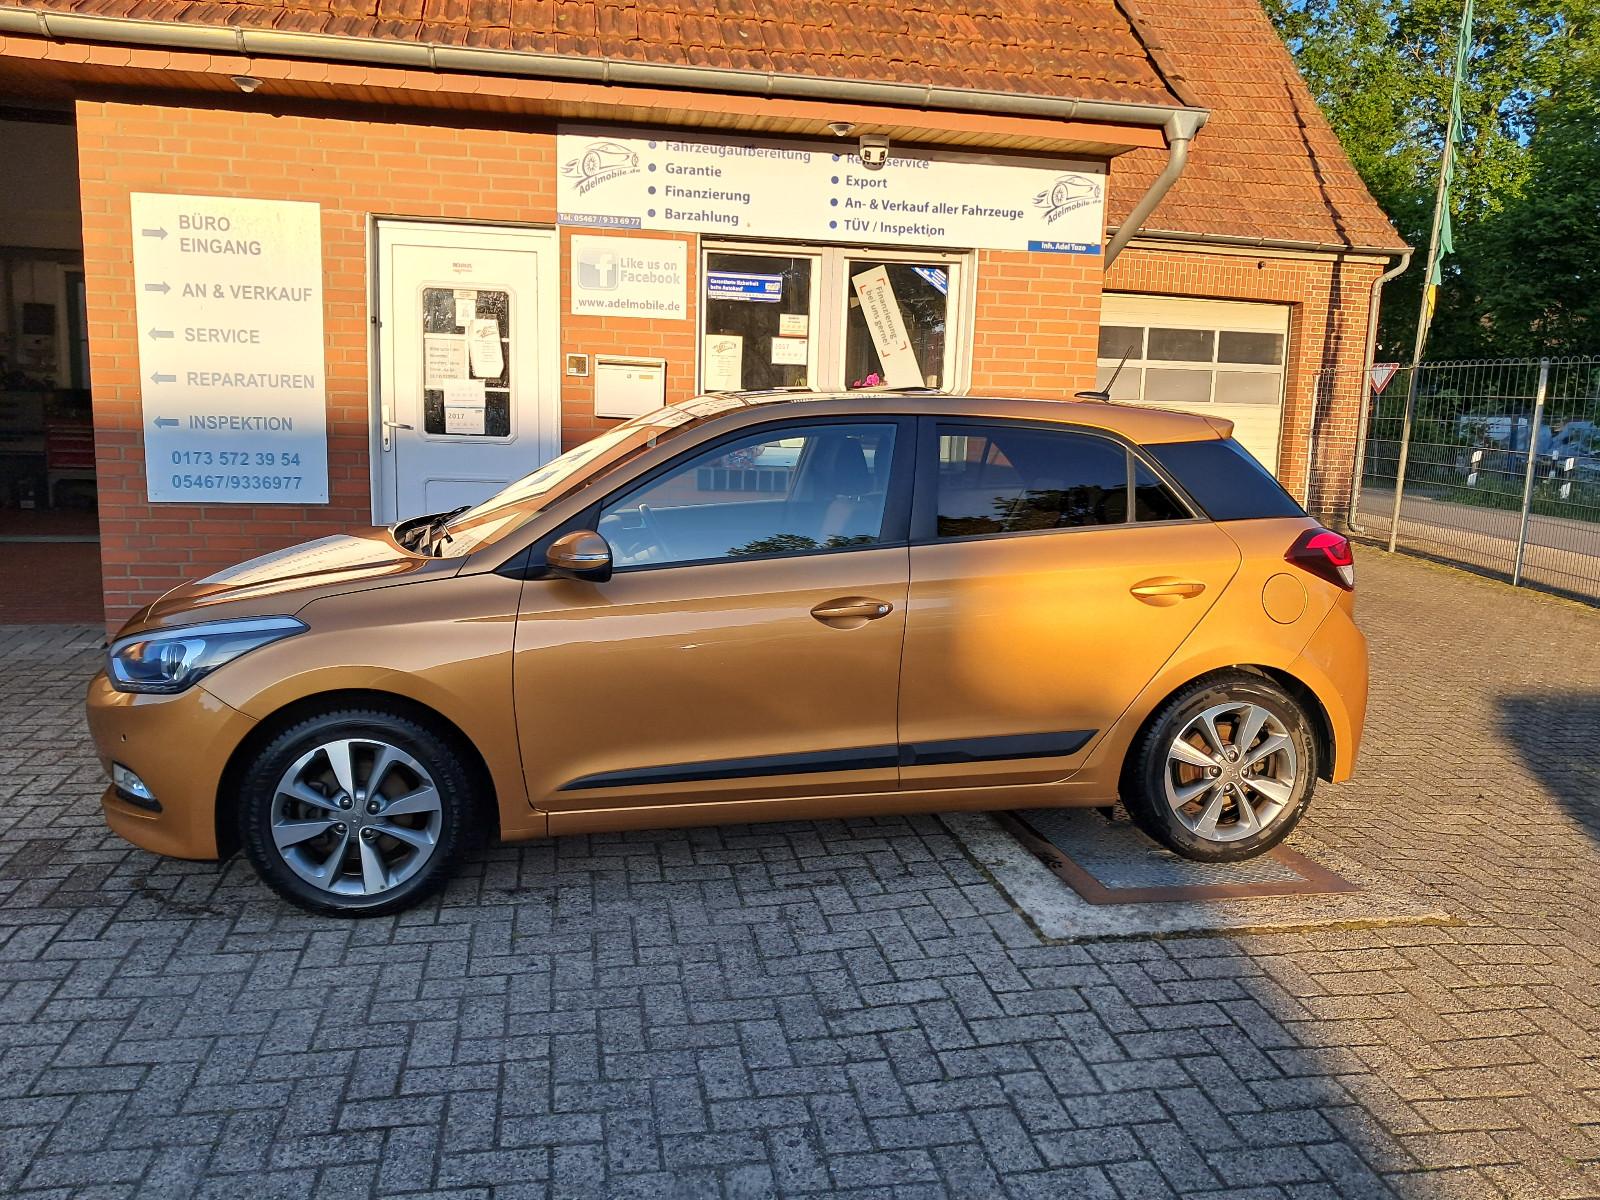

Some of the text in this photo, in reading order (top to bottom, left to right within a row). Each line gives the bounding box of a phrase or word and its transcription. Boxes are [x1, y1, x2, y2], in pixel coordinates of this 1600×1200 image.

[665, 140, 811, 163] Fahrzeugaufbereitung
[665, 162, 722, 178] Garantie
[845, 174, 888, 190] Export
[665, 185, 750, 205] Finanzierung
[665, 208, 739, 227] Barzahlung
[845, 198, 1025, 221] An- & Verkauf aller Fahrzeuge
[178, 212, 231, 232] BÜRO
[573, 214, 597, 223] 05467
[609, 216, 619, 224] 33
[620, 217, 630, 225] 69
[630, 217, 640, 226] 77
[844, 217, 945, 236] TÜV / Inspektion
[180, 237, 262, 256] EINGANG
[620, 257, 677, 271] Like us on
[620, 270, 681, 285] Facebook
[182, 282, 313, 302] AN & VERKAUF
[578, 298, 681, 312] www.adelmobile.de
[875, 286, 898, 340] Finanzierung
[865, 289, 891, 347] bei uns gerne!
[184, 327, 261, 344] SERVICE
[187, 371, 316, 389] REPARATUREN
[189, 415, 293, 431] INSPEKTION
[171, 450, 301, 467] 0173 572 39 54
[171, 474, 303, 490] 05467/9336977
